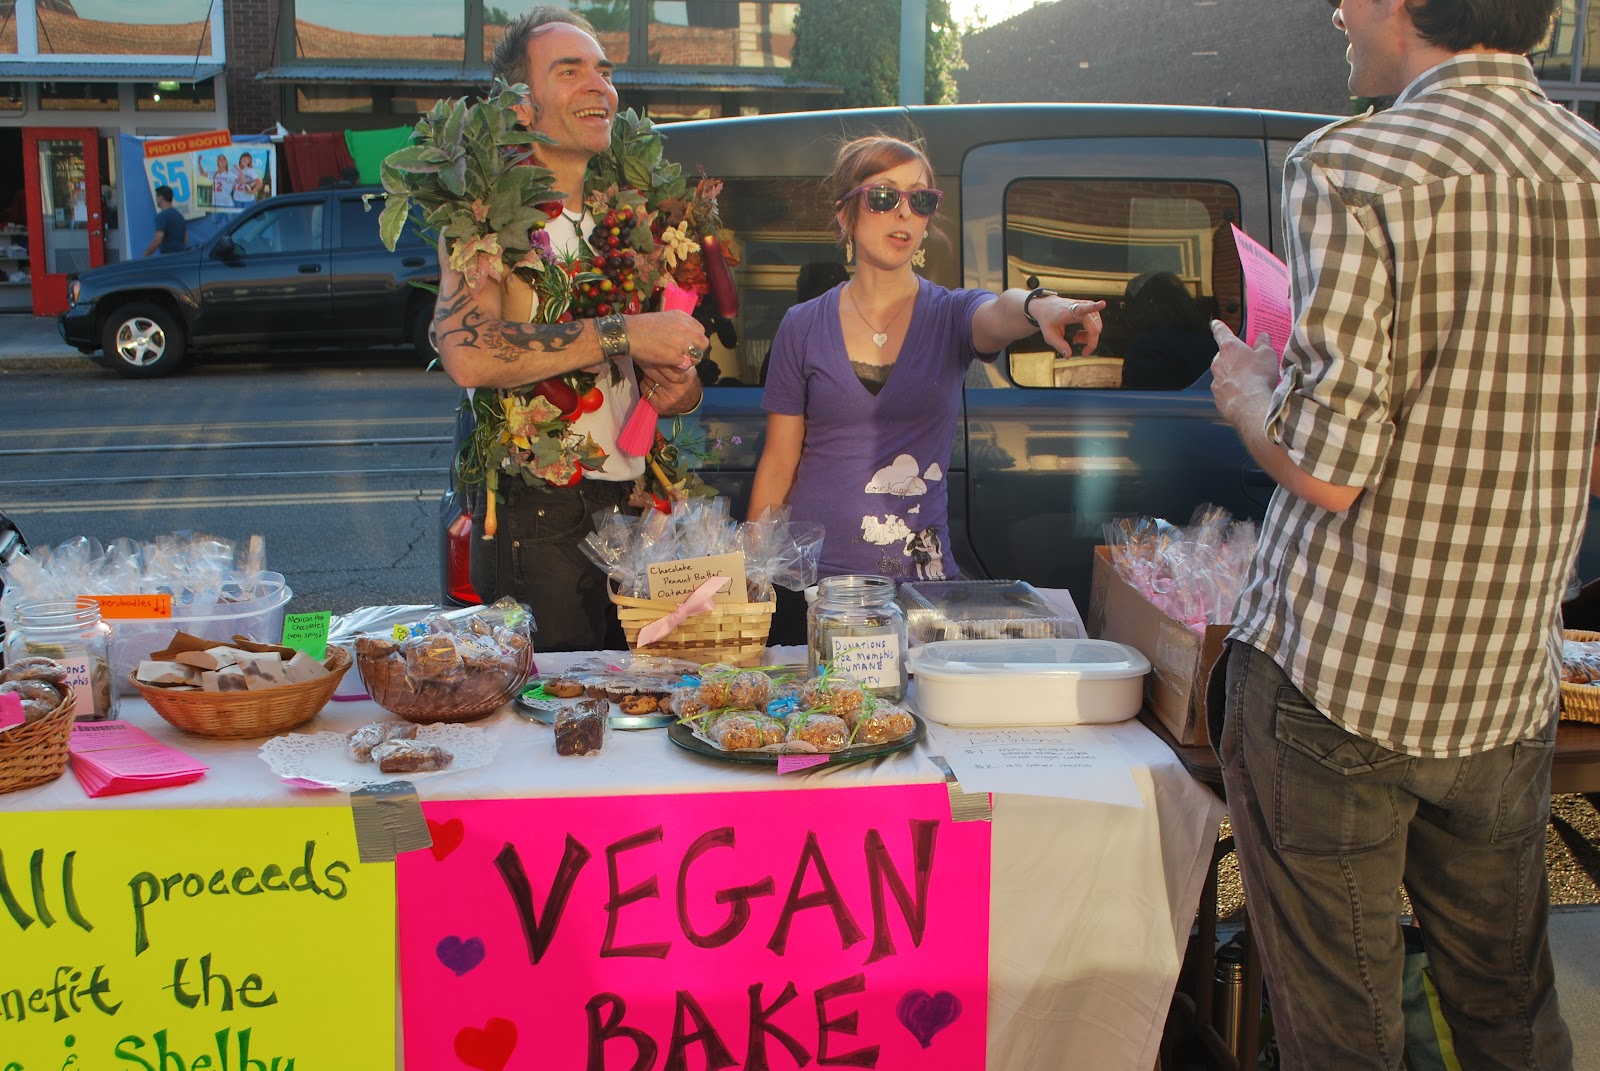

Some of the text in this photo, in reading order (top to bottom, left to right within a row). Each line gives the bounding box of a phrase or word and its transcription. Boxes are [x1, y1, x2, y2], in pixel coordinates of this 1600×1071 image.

[148, 135, 227, 155] PHOTO BOOTH
[151, 159, 191, 203] $5
[650, 564, 693, 575] Chocolate
[663, 570, 723, 585] Peanut Butter
[657, 584, 696, 598] Oatmeal
[99, 598, 151, 607] ckerdoodles
[292, 622, 325, 631] Chocolates
[64, 676, 89, 689] mphis
[128, 840, 351, 957] proceeds
[494, 819, 940, 965] VEGAN
[0, 953, 278, 1023] nefit the
[585, 973, 880, 1071] BAKE
